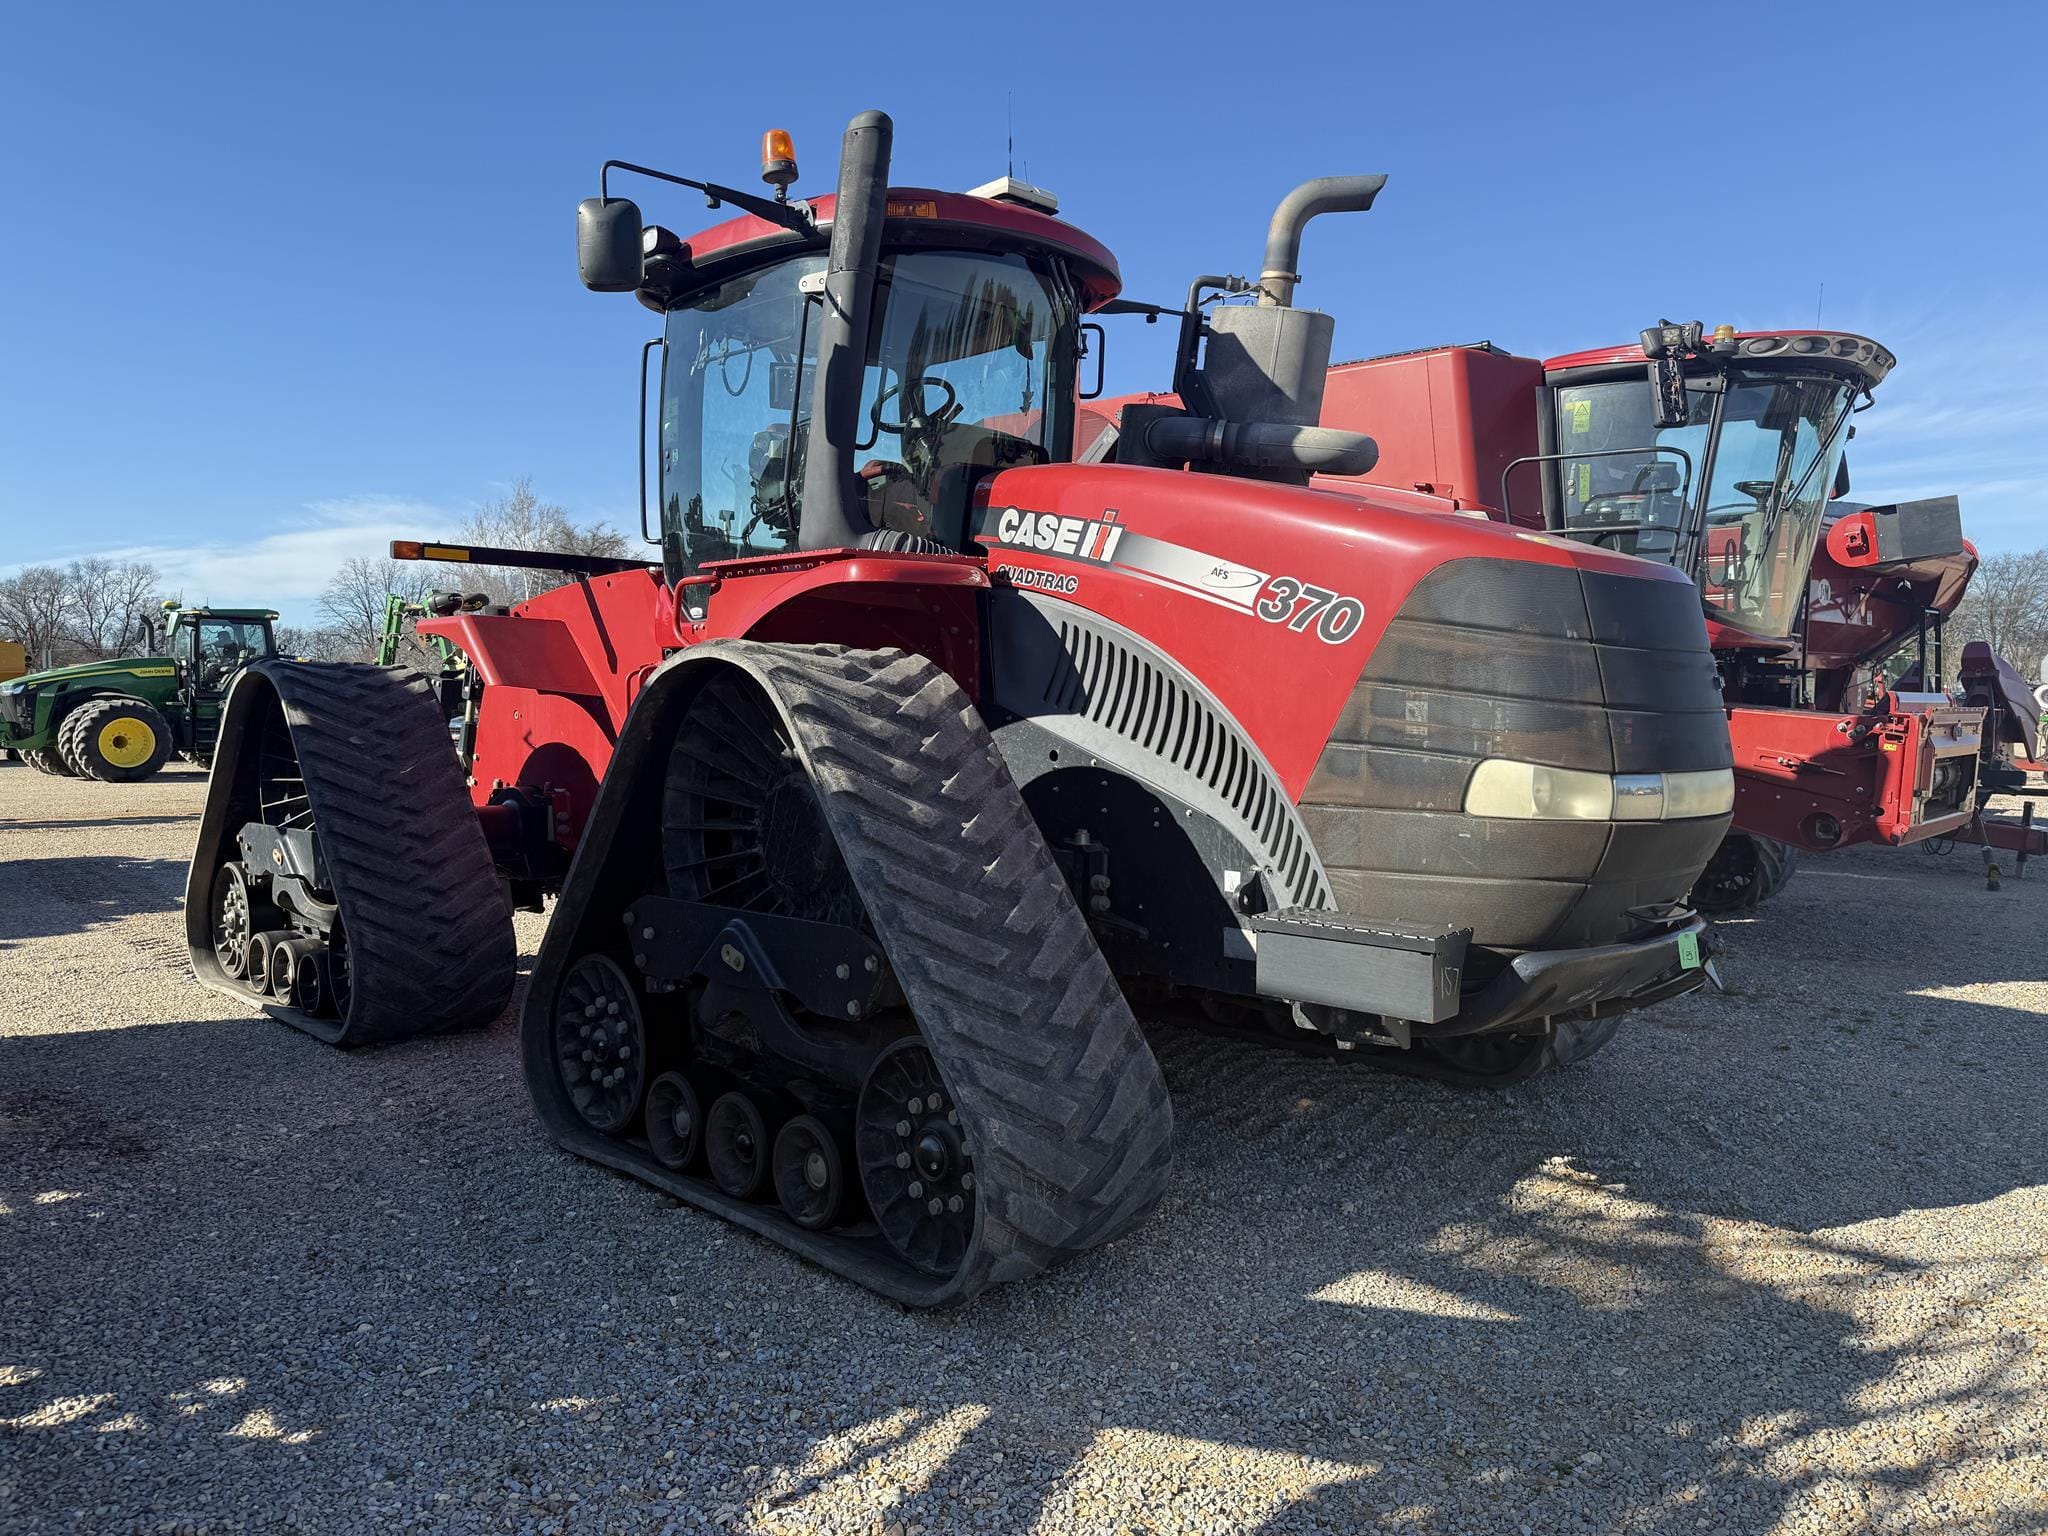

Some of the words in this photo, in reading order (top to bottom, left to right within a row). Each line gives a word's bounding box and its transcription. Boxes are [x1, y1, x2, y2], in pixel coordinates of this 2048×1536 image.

[998, 508, 1084, 555] CASE
[1211, 567, 1229, 580] AFS
[1256, 576, 1365, 645] 370
